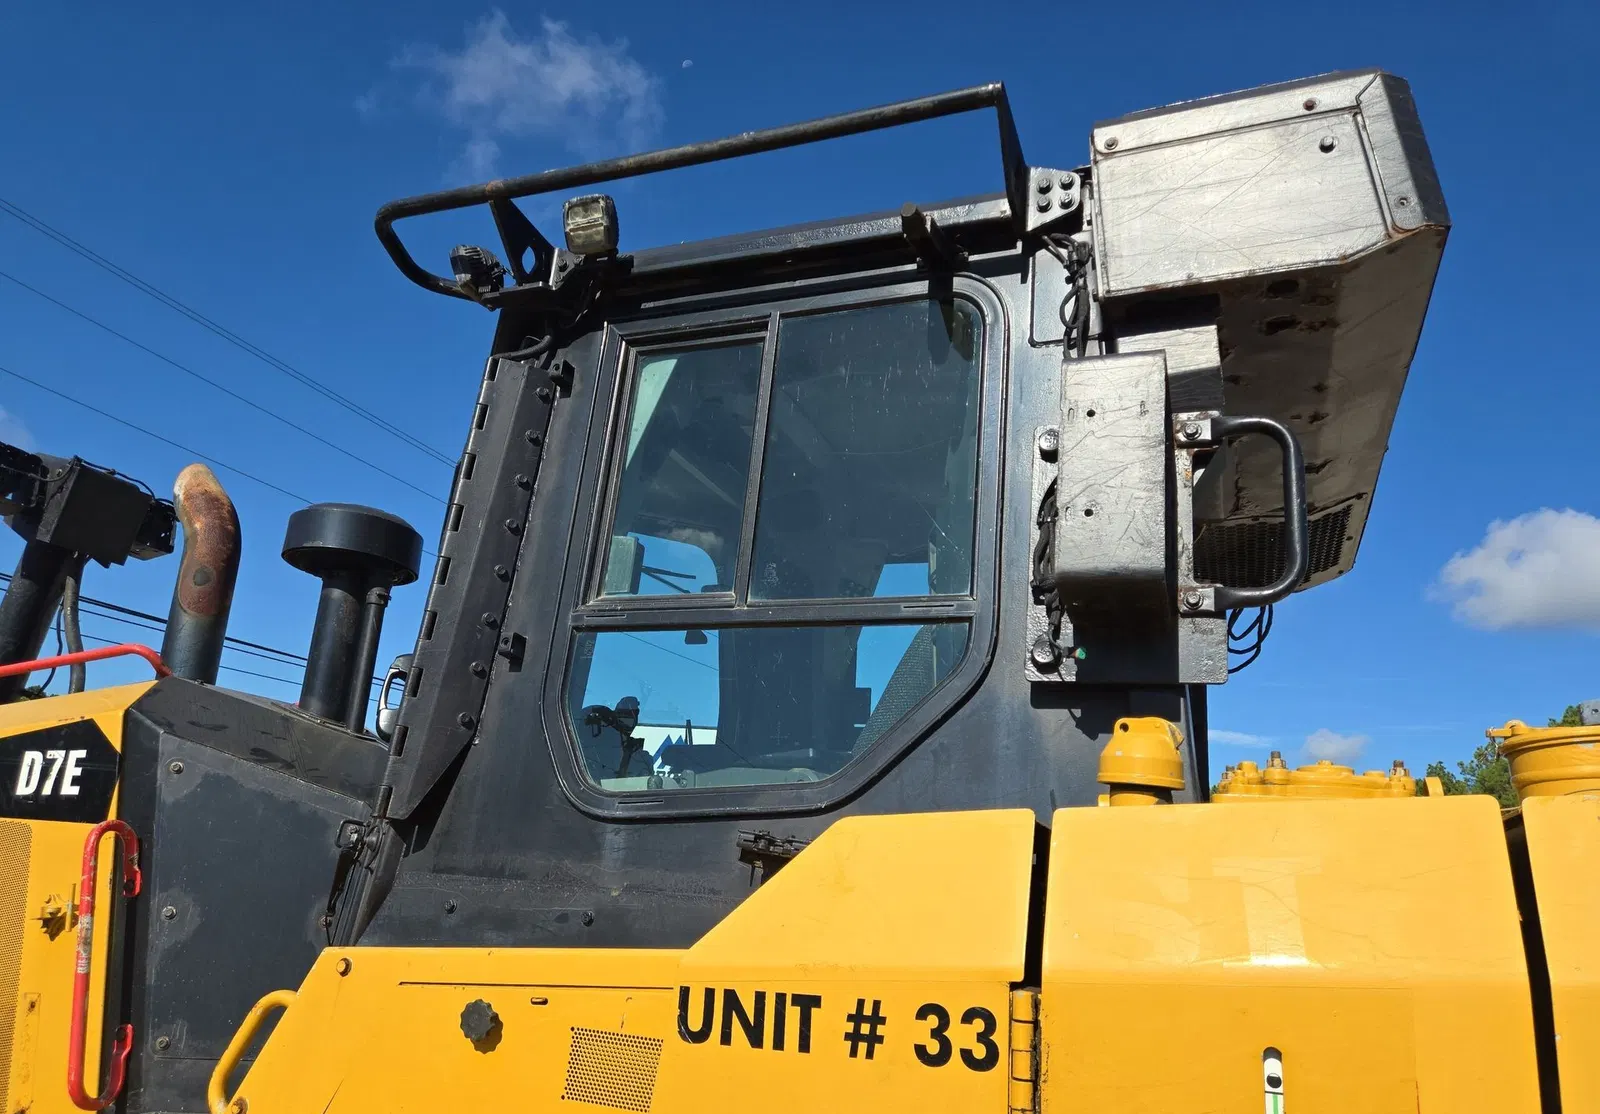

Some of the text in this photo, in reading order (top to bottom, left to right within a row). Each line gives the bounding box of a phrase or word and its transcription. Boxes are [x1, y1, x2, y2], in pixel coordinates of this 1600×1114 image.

[15, 749, 88, 796] D7E
[677, 985, 1000, 1072] UNIT # 33
